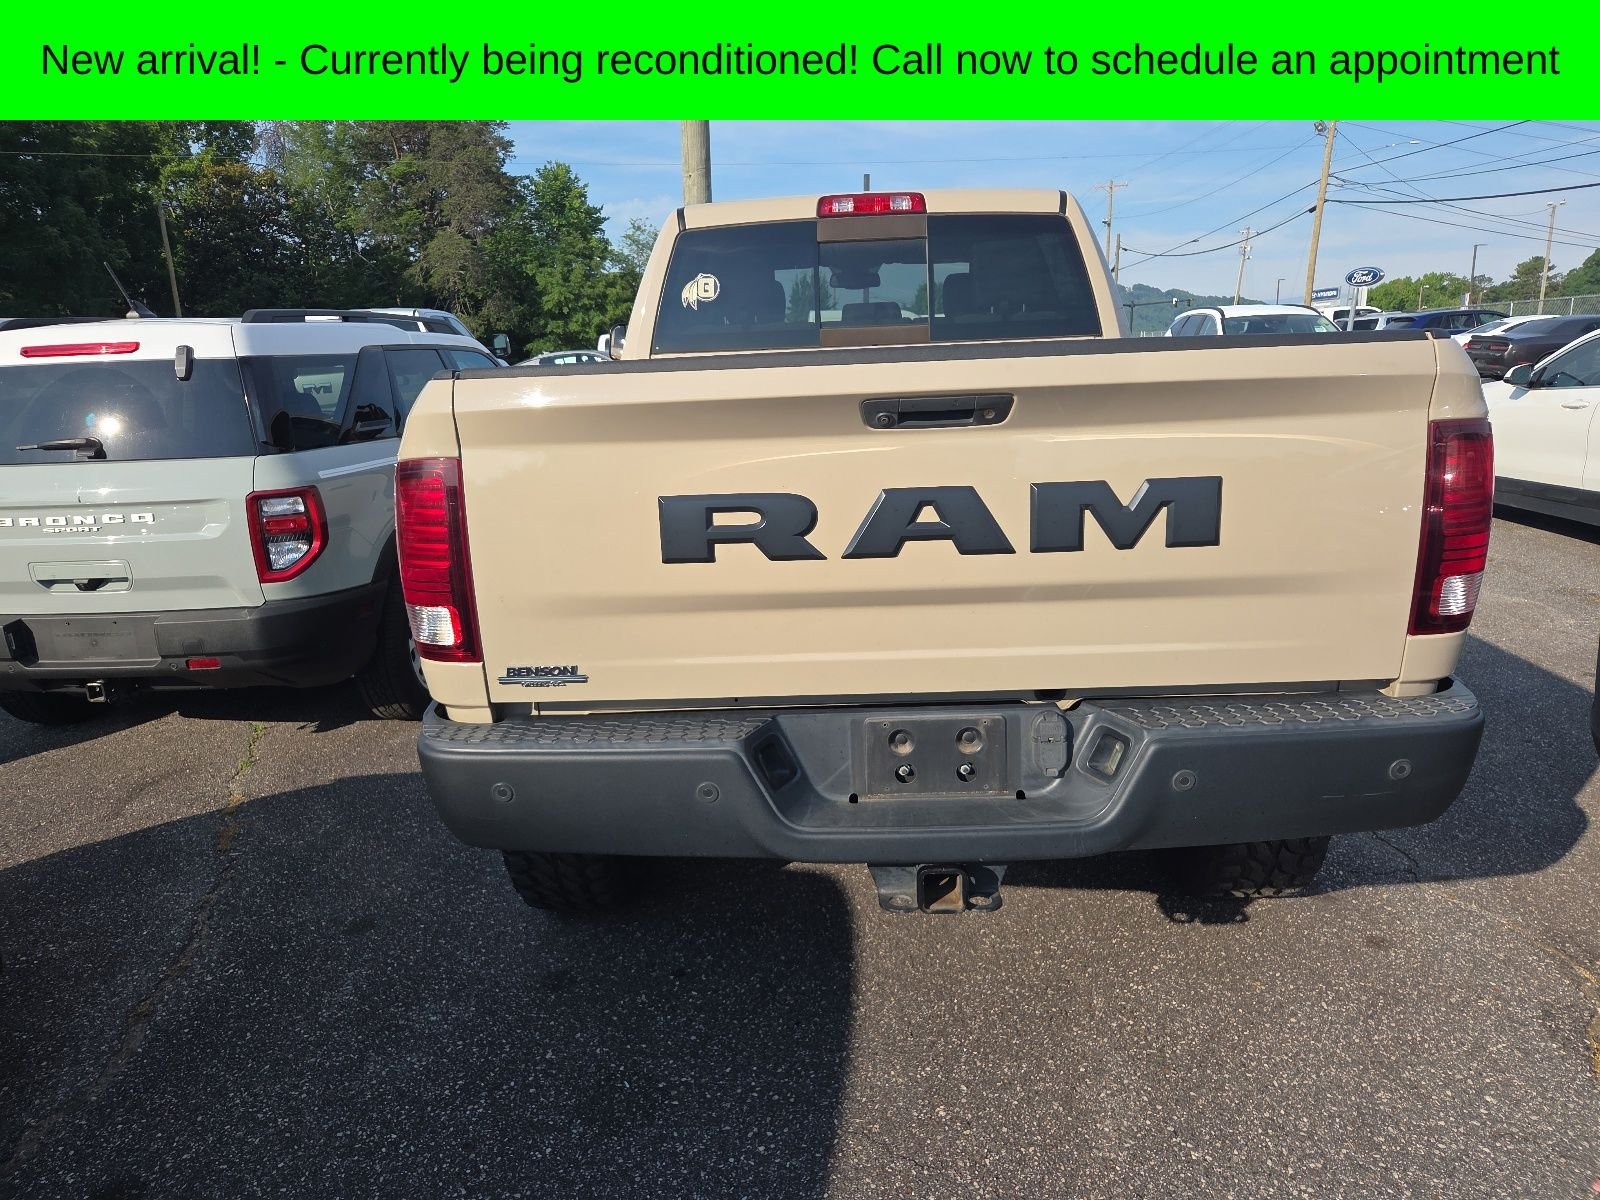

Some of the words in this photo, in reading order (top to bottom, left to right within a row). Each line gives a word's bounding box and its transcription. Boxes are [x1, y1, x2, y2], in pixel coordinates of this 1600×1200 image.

[1351, 271, 1374, 283] Ford
[658, 476, 1222, 563] RAM
[506, 665, 578, 678] BENSON
